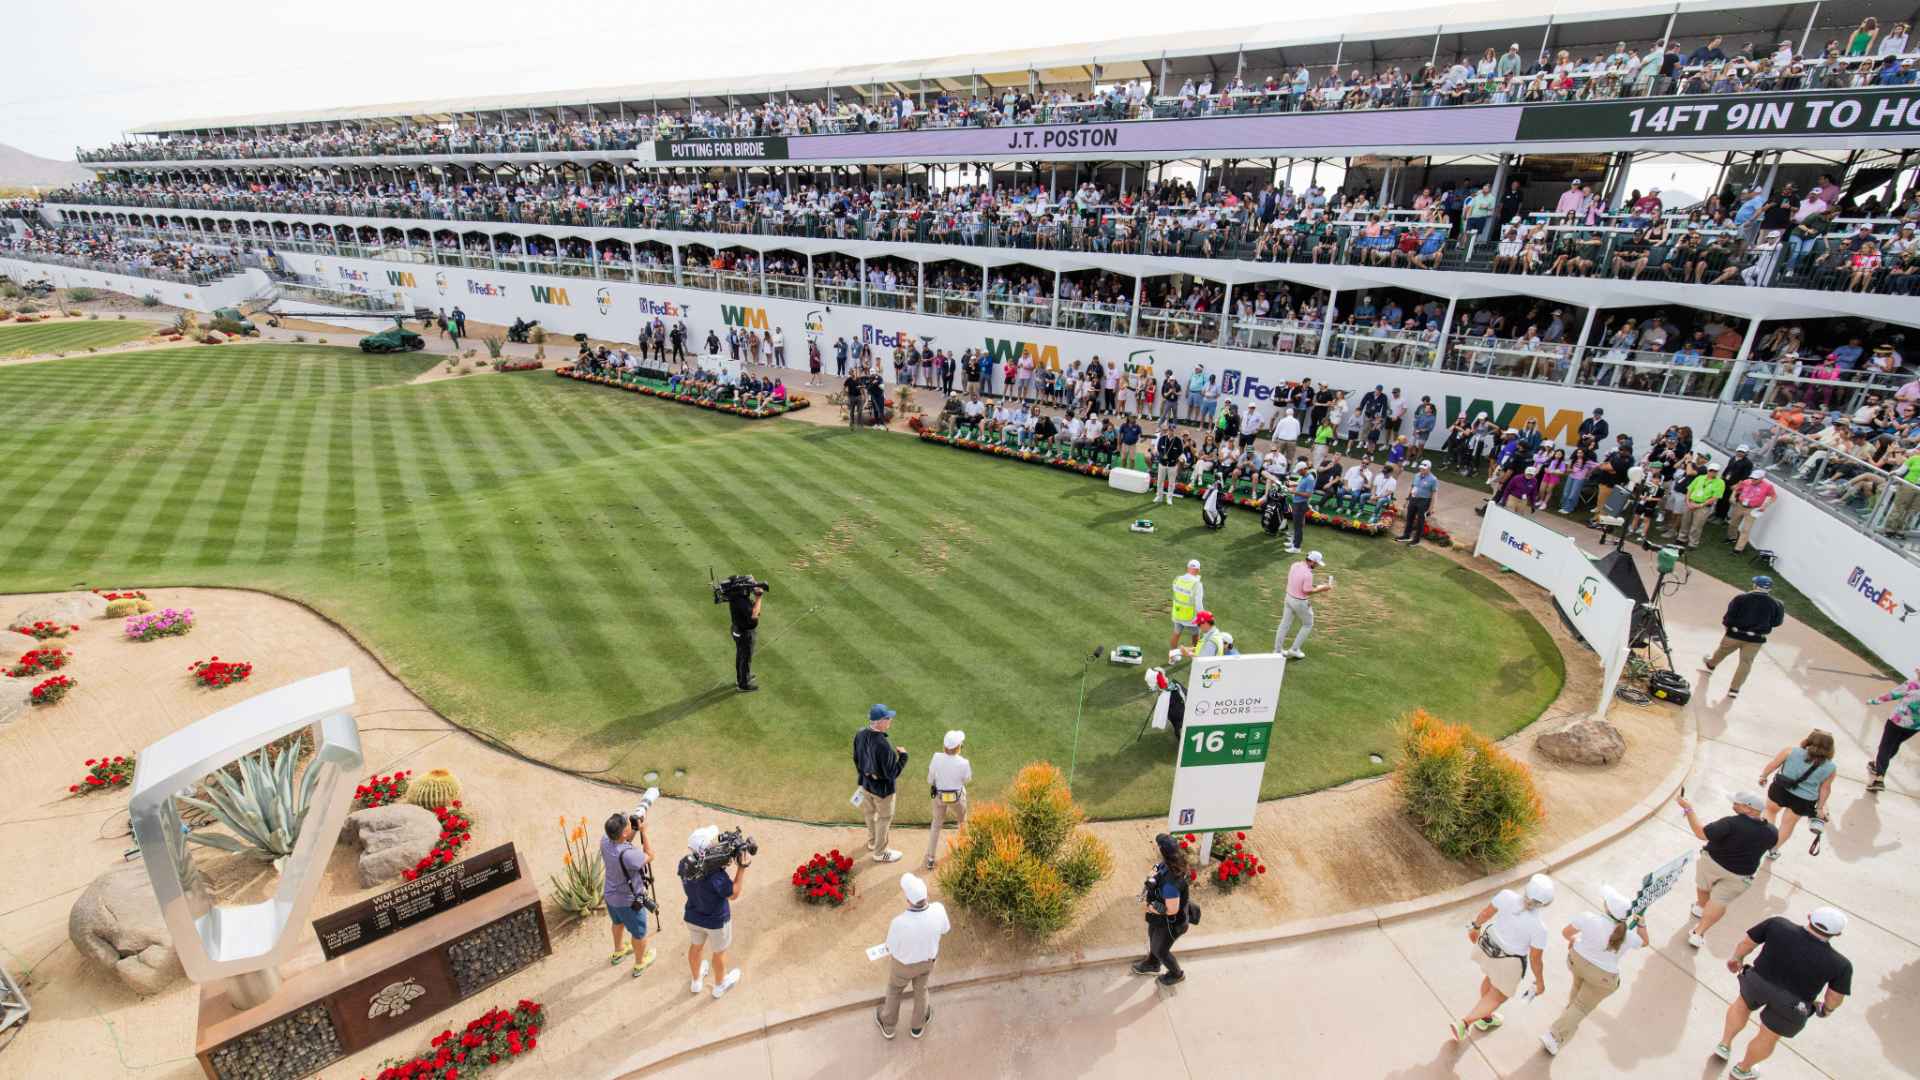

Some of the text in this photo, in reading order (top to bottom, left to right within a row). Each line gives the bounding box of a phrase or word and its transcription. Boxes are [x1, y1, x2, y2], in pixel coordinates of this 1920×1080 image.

[1628, 104, 1718, 133] 14FT
[1725, 102, 1794, 131] 9IN
[1805, 99, 1862, 129] TO
[1008, 128, 1118, 149] J.T. POSTON
[671, 142, 765, 157] PUTTING FOR BIRDIE
[386, 270, 416, 288] WM
[530, 285, 571, 305] WM
[649, 301, 679, 317] FedEx
[720, 304, 769, 329] WM
[805, 322, 824, 332] WM
[875, 329, 916, 349] FedEx
[985, 337, 1061, 373] WM
[1445, 395, 1584, 447] WM
[1508, 536, 1532, 556] FedEx
[1858, 576, 1898, 615] FedEx
[1213, 706, 1251, 716] COORS
[1214, 697, 1262, 706] MOLSON
[1190, 730, 1226, 753] 16
[1253, 731, 1261, 740] 3
[372, 891, 393, 905] WM
[393, 874, 438, 897] PHOENIX
[438, 863, 465, 882] OPEN
[373, 895, 409, 912] HOLES
[409, 888, 421, 899] IN
[422, 880, 444, 892] ONE
[445, 874, 456, 886] AT
